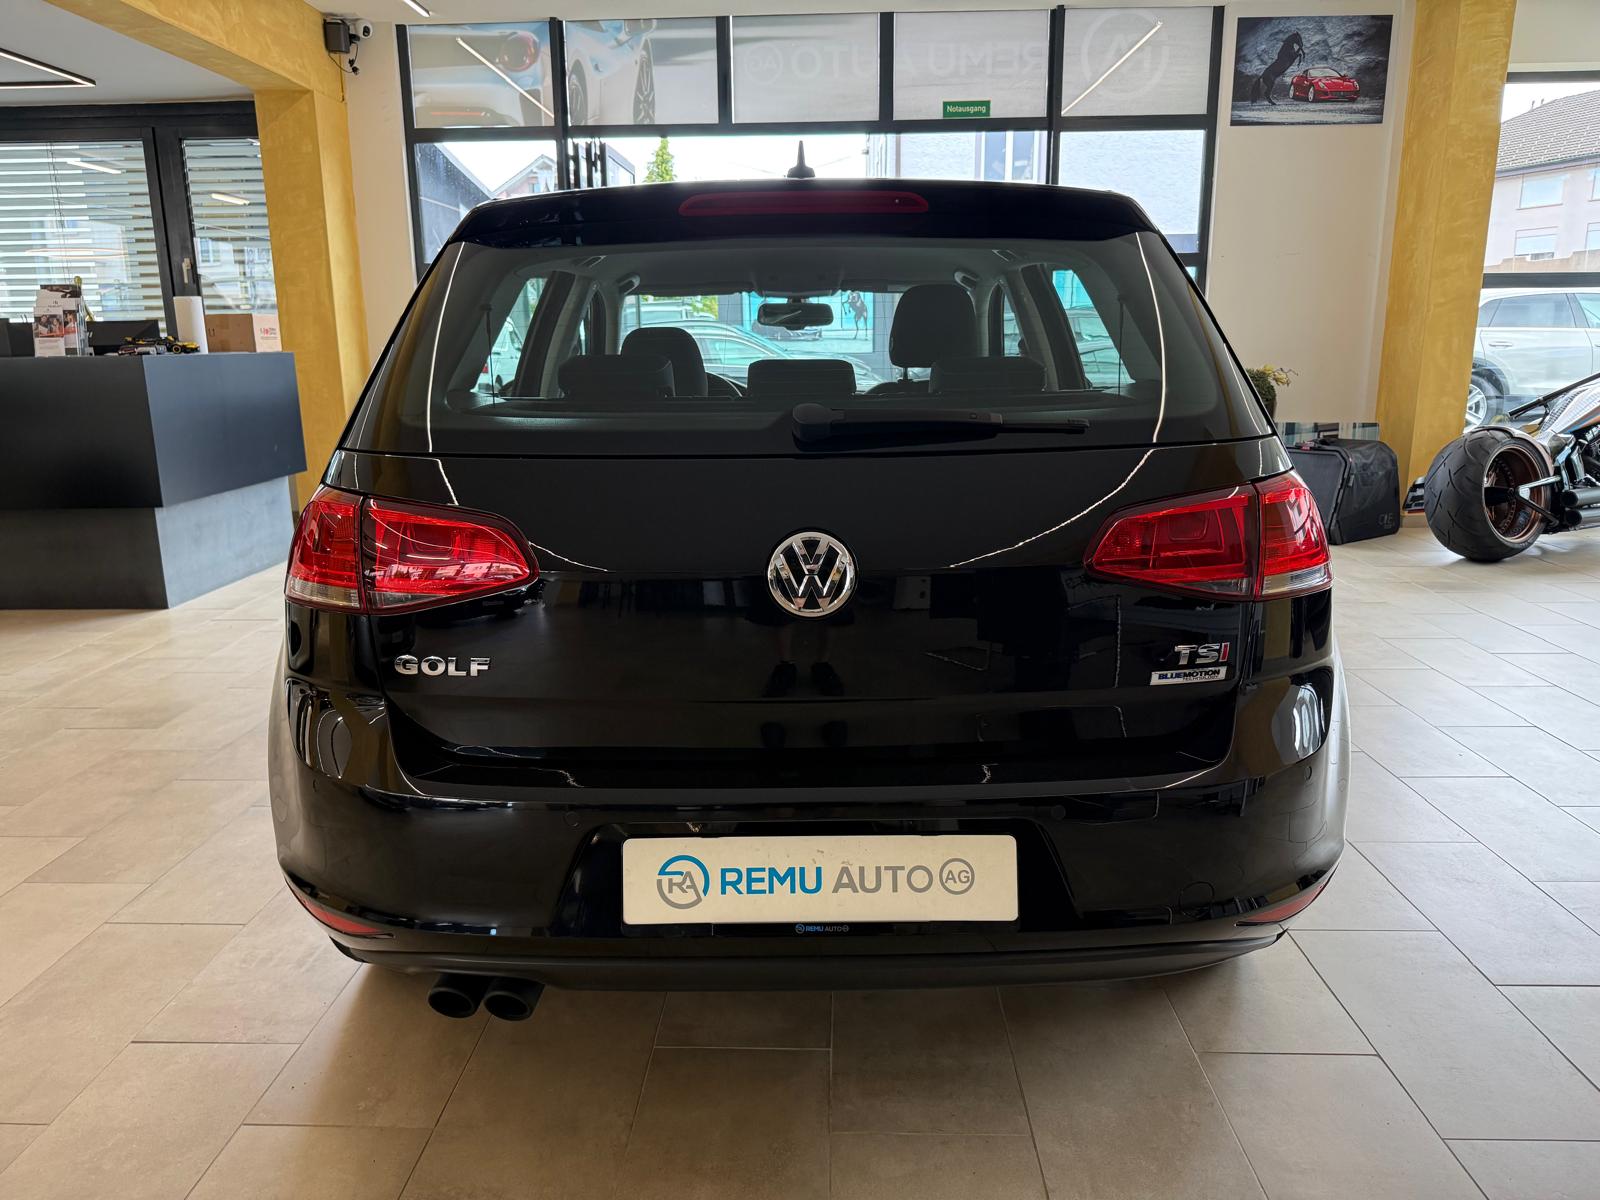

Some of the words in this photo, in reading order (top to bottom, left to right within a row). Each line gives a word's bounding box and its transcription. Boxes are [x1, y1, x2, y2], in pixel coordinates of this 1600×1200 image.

[946, 104, 987, 113] Notausgang
[1174, 642, 1230, 665] TSI
[394, 654, 491, 676] GOLF
[1158, 669, 1221, 680] BLUEMOTION
[720, 866, 822, 895] REMU
[832, 865, 933, 893] AUTO
[944, 869, 970, 884] AG
